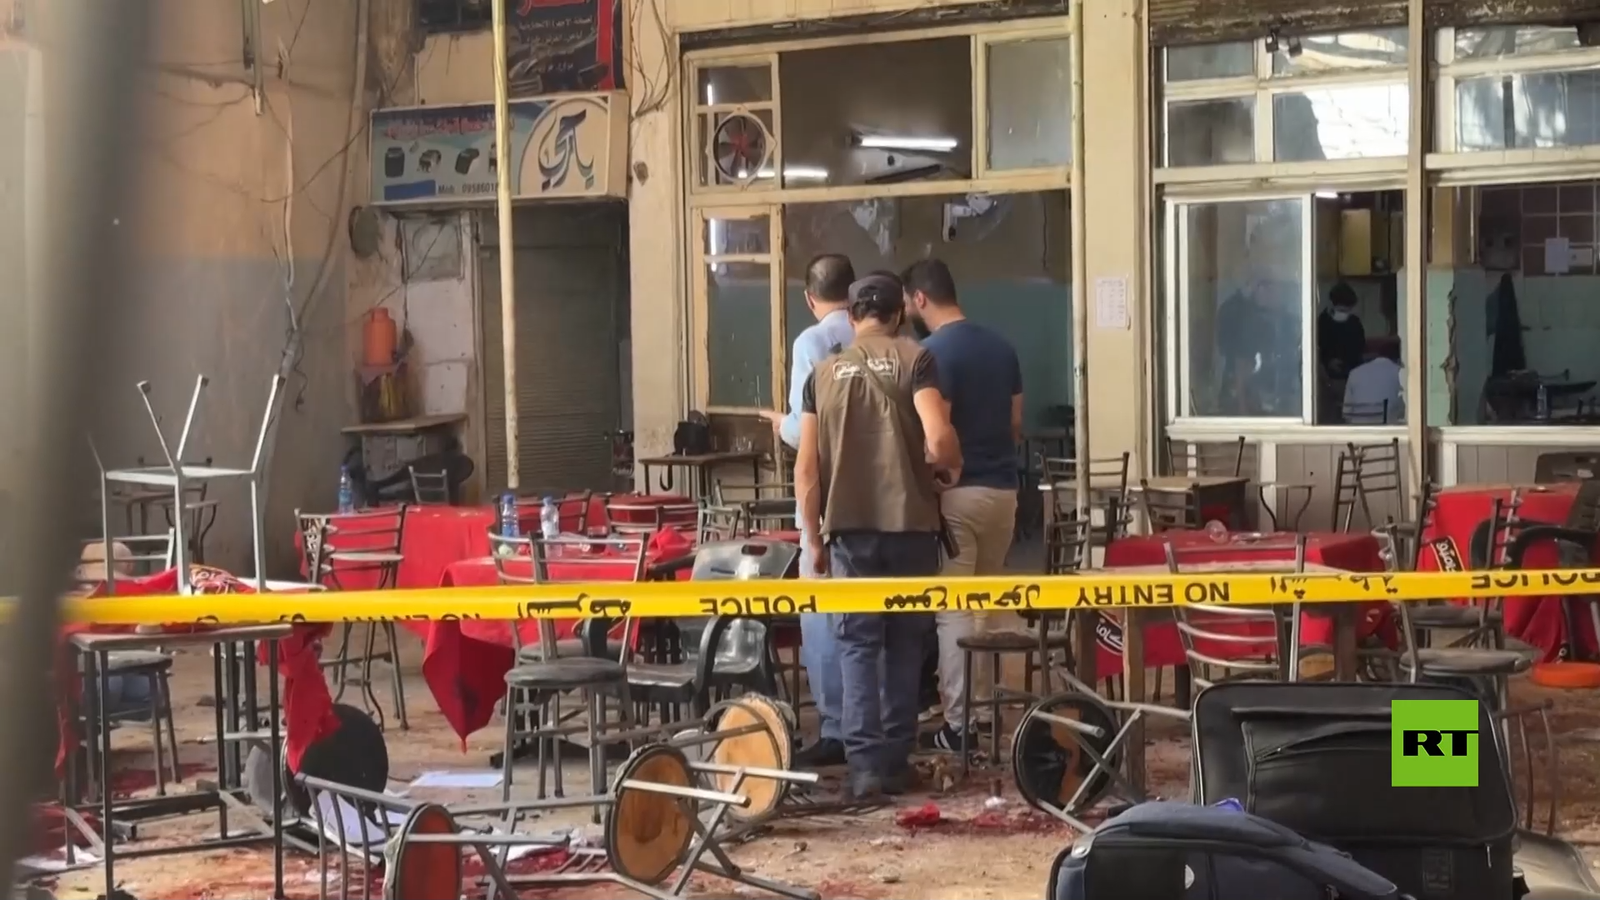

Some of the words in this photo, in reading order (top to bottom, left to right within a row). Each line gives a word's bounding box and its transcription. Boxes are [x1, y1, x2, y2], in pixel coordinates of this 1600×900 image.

[884, 586, 948, 610] ممنوع
[1076, 584, 1173, 606] ENTRY
[1184, 582, 1230, 603] NO
[700, 595, 817, 615] POLICE
